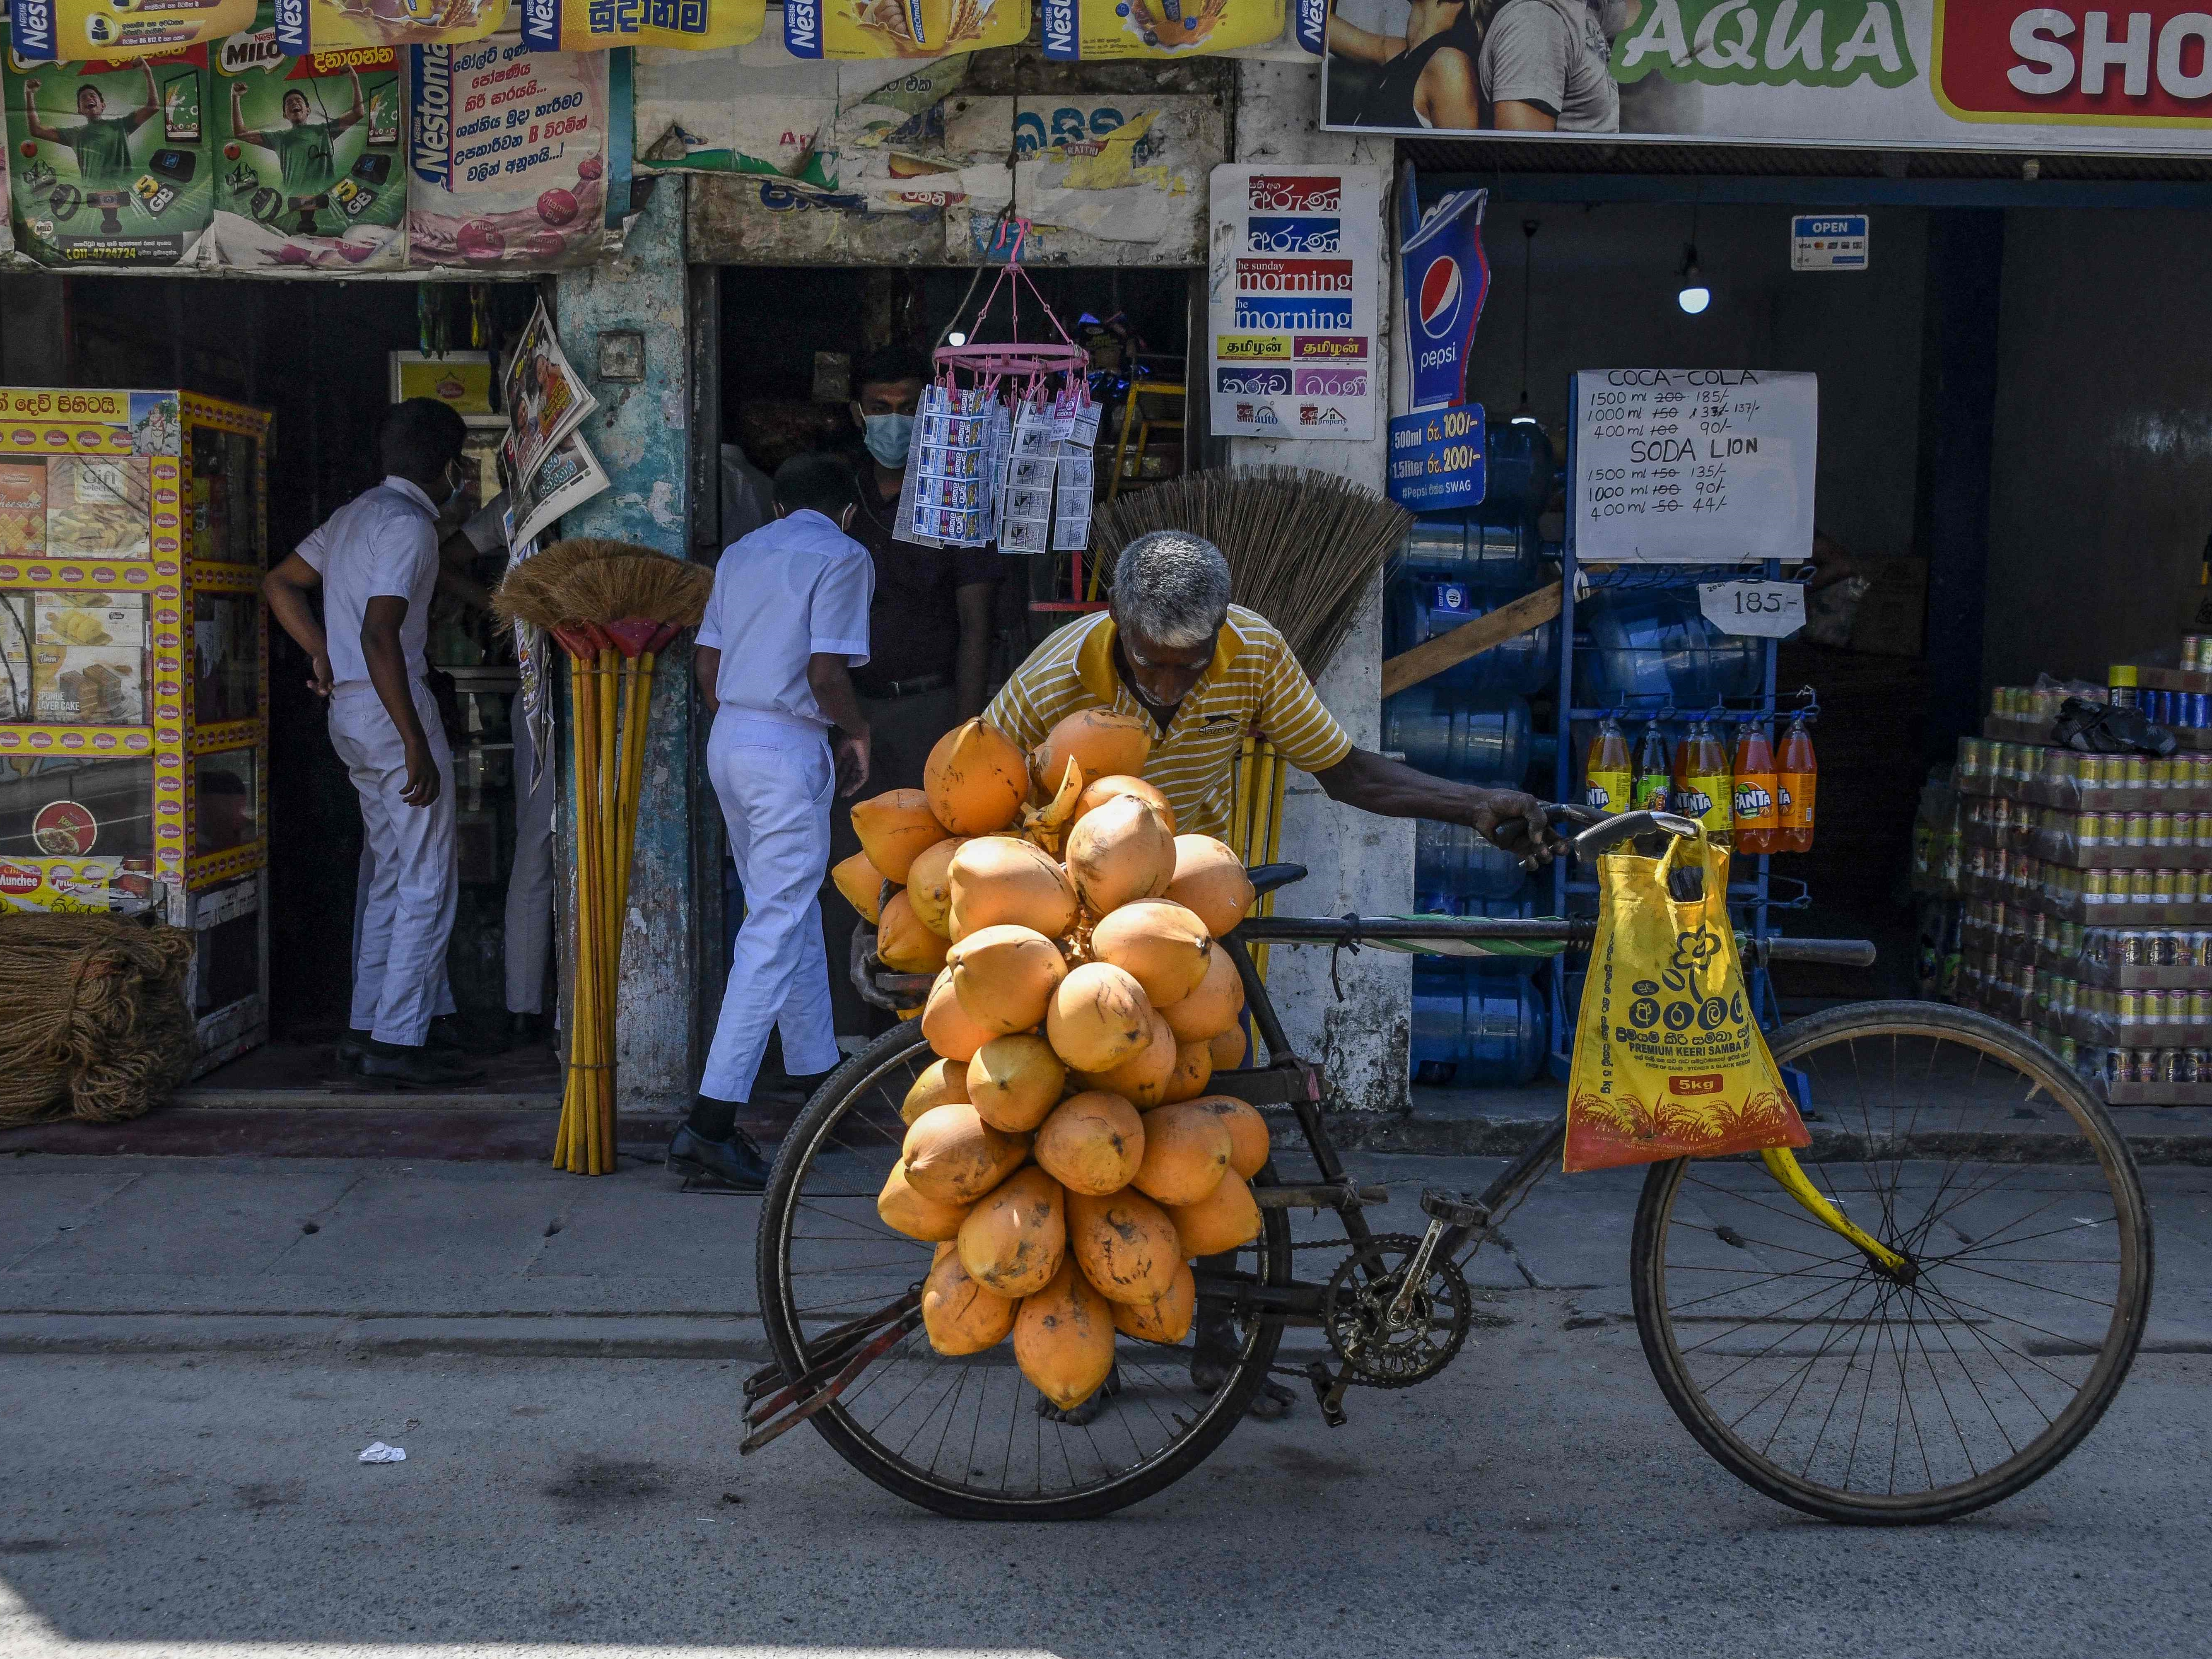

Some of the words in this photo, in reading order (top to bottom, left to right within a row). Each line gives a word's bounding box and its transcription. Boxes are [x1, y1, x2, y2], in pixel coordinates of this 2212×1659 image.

[23, 0, 48, 50] Nes
[278, 0, 303, 45] Nes
[791, 0, 815, 48] Nes
[254, 31, 275, 43] Nestl
[226, 40, 280, 65] MILO
[1621, 0, 1903, 71] AQUA
[2006, 7, 2212, 99] SHO
[415, 43, 449, 174] Nestoma
[528, 125, 538, 144] B
[133, 174, 159, 200] 5
[334, 178, 358, 203] 5
[149, 188, 174, 212] GB
[347, 190, 373, 216] GB
[541, 194, 572, 216] Vitamin
[1812, 222, 1848, 233] OPEN
[1249, 225, 1341, 252] අරුණ
[1235, 260, 1250, 271] he
[1251, 261, 1284, 273] sunday
[1235, 270, 1353, 291] morning
[1235, 299, 1248, 309] he
[1234, 308, 1353, 330] morning
[1225, 336, 1282, 355] தமிழன்
[1302, 338, 1359, 356] தமிழன்
[1420, 341, 1457, 373] pepsi
[1607, 368, 1759, 386] COCA-COLA
[15, 394, 51, 416] දෙවි
[1591, 392, 1626, 406] 1500
[1631, 392, 1647, 402] ml
[1696, 388, 1730, 404] 185/-
[1254, 414, 1278, 425] auto
[1588, 408, 1626, 422] 1000
[1627, 408, 1642, 419] ml
[1394, 428, 1422, 449] 500ml
[1443, 412, 1479, 439] 100/-
[1593, 426, 1626, 440] 400
[1627, 425, 1644, 437] ml
[1701, 422, 1732, 437] 90/-
[1630, 438, 1696, 463] SODA
[1710, 437, 1758, 458] LION
[1392, 461, 1424, 479] 1.5liter
[1443, 445, 1481, 473] 200/-
[83, 470, 118, 485] Gift
[1588, 468, 1626, 482] 1500
[1631, 468, 1647, 479] ml
[1691, 463, 1727, 479] 135/-
[1402, 485, 1428, 499] #Pepsi
[1445, 479, 1471, 493] SWAG
[1589, 487, 1624, 502] 1000
[1631, 485, 1648, 495] ml
[1591, 503, 1625, 522] 400
[1628, 502, 1646, 514] ml
[1693, 495, 1727, 513] 44/-
[37, 692, 65, 701] SPONGE
[37, 701, 60, 710] LAYER
[61, 702, 80, 711] CAKE
[1587, 788, 1609, 805] NTA
[1690, 792, 1711, 810] NTA
[1735, 790, 1771, 810] FANTA
[1629, 1042, 1674, 1057] PREMIUM
[1676, 1045, 1706, 1057] KEERI
[1708, 1040, 1741, 1056] SAMBA
[1600, 1080, 1614, 1095] kg
[1679, 1079, 1714, 1090] 5kg
